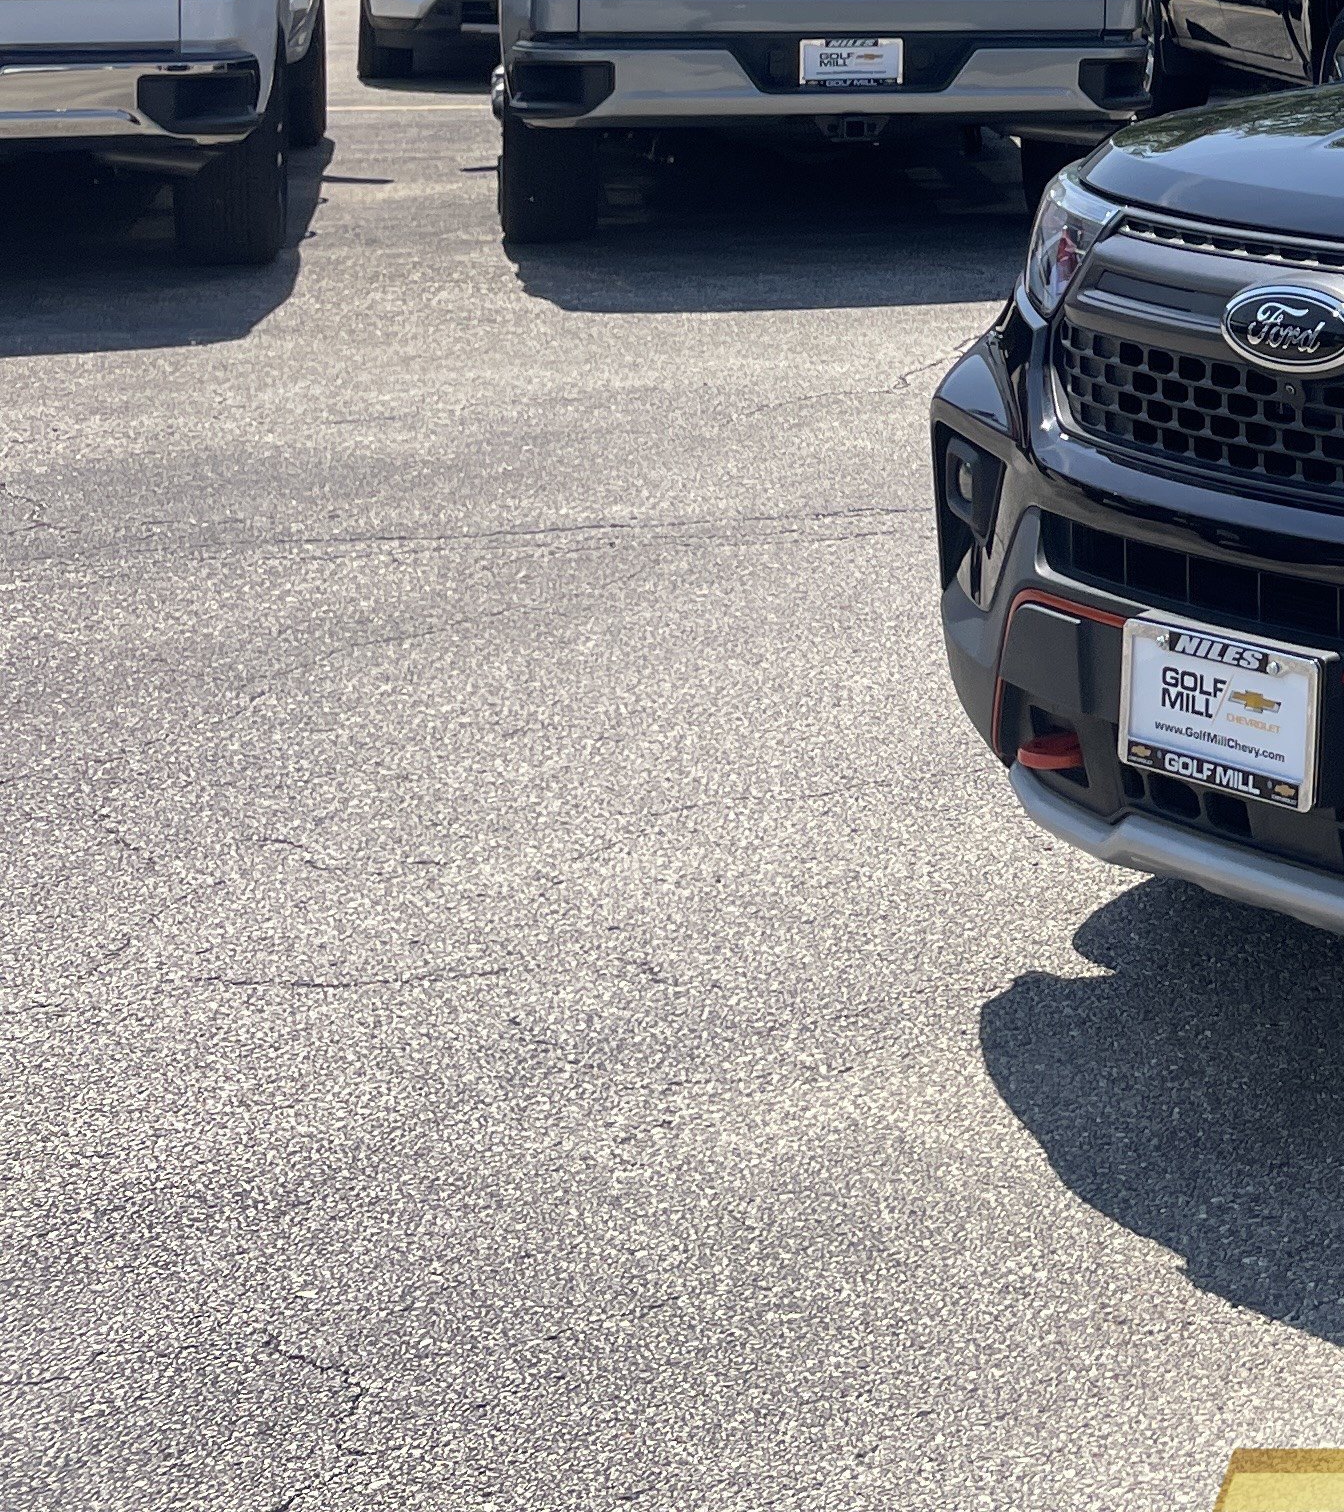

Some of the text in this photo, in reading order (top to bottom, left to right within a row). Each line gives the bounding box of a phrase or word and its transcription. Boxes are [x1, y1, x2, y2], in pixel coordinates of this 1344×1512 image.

[1246, 301, 1326, 354] Ford
[1174, 634, 1264, 670] NILES
[1161, 666, 1228, 698] GOLF
[1161, 687, 1213, 719] MILL
[1154, 720, 1286, 763] www.GolfMillChevy.com
[1226, 712, 1281, 735] CHEVROLET
[1164, 752, 1261, 795] GOLF MILL
